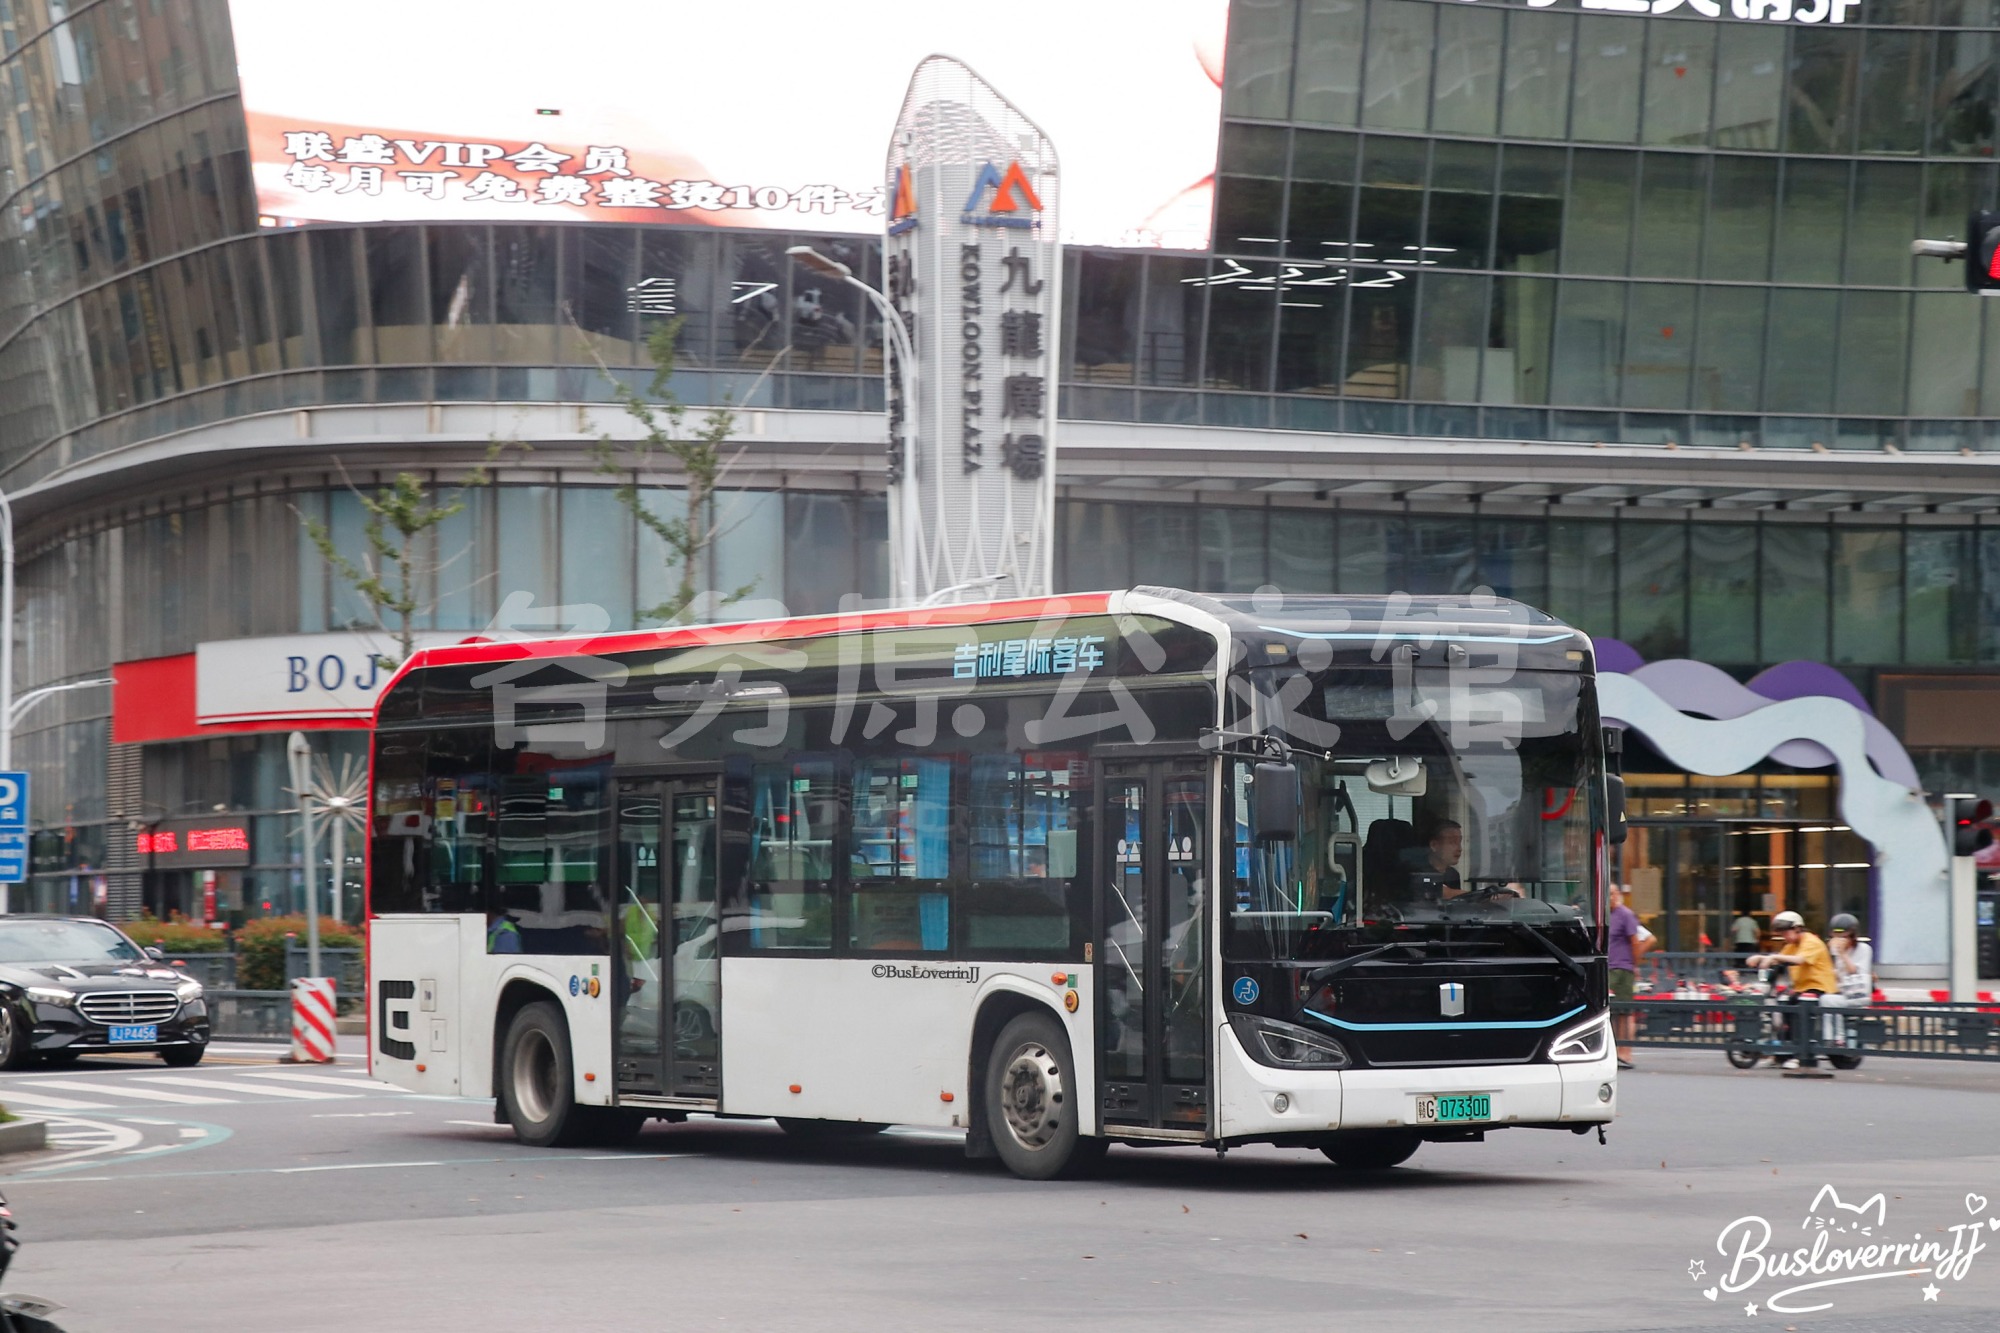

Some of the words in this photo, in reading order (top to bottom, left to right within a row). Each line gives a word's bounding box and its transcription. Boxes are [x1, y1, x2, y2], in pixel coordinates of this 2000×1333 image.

[284, 131, 630, 178] 联盛VIP会员
[961, 244, 982, 381] KOWLOON
[1000, 246, 1044, 481] 九龍廣場
[962, 389, 982, 475] PLAZA
[286, 653, 384, 693] BOJ
[953, 635, 1105, 679] 吉利星际客车
